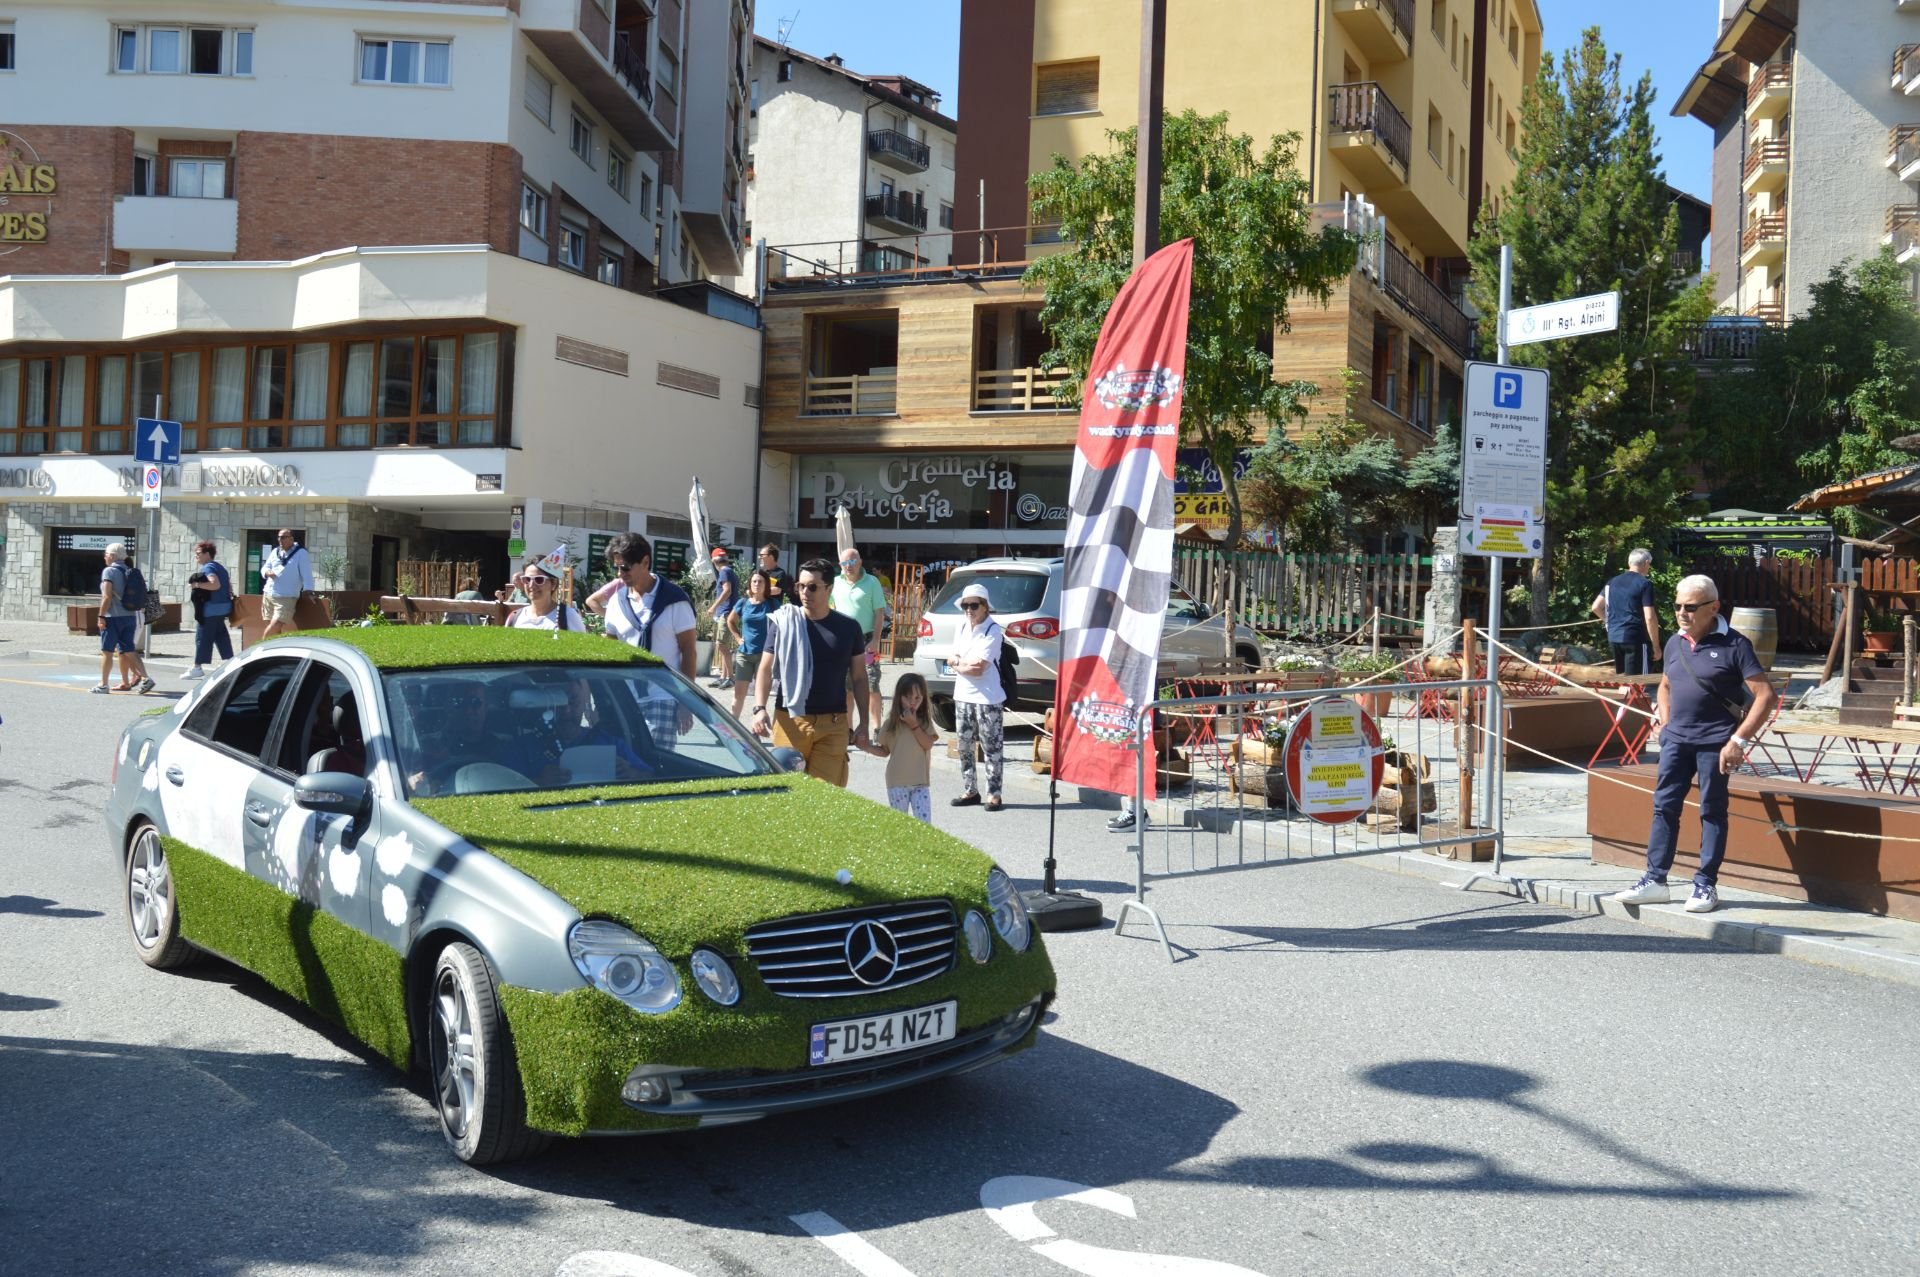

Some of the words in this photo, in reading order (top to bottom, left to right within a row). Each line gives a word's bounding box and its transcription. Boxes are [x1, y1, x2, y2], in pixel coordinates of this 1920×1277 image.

[1585, 300, 1605, 311] piazza
[1558, 317, 1576, 330] Rgt.
[1580, 310, 1605, 327] Alpini
[1499, 376, 1517, 404] P
[1473, 410, 1504, 420] parcheggio
[1490, 422, 1501, 430] pay
[1501, 423, 1523, 432] parking
[205, 464, 299, 488] SANPAOLO
[879, 454, 1017, 494] Cremeria
[809, 471, 953, 523] Pasticceria
[1195, 501, 1231, 515] GAL
[824, 1018, 894, 1057] FD54
[901, 1007, 947, 1044] NZT
[812, 1050, 824, 1060] UK
